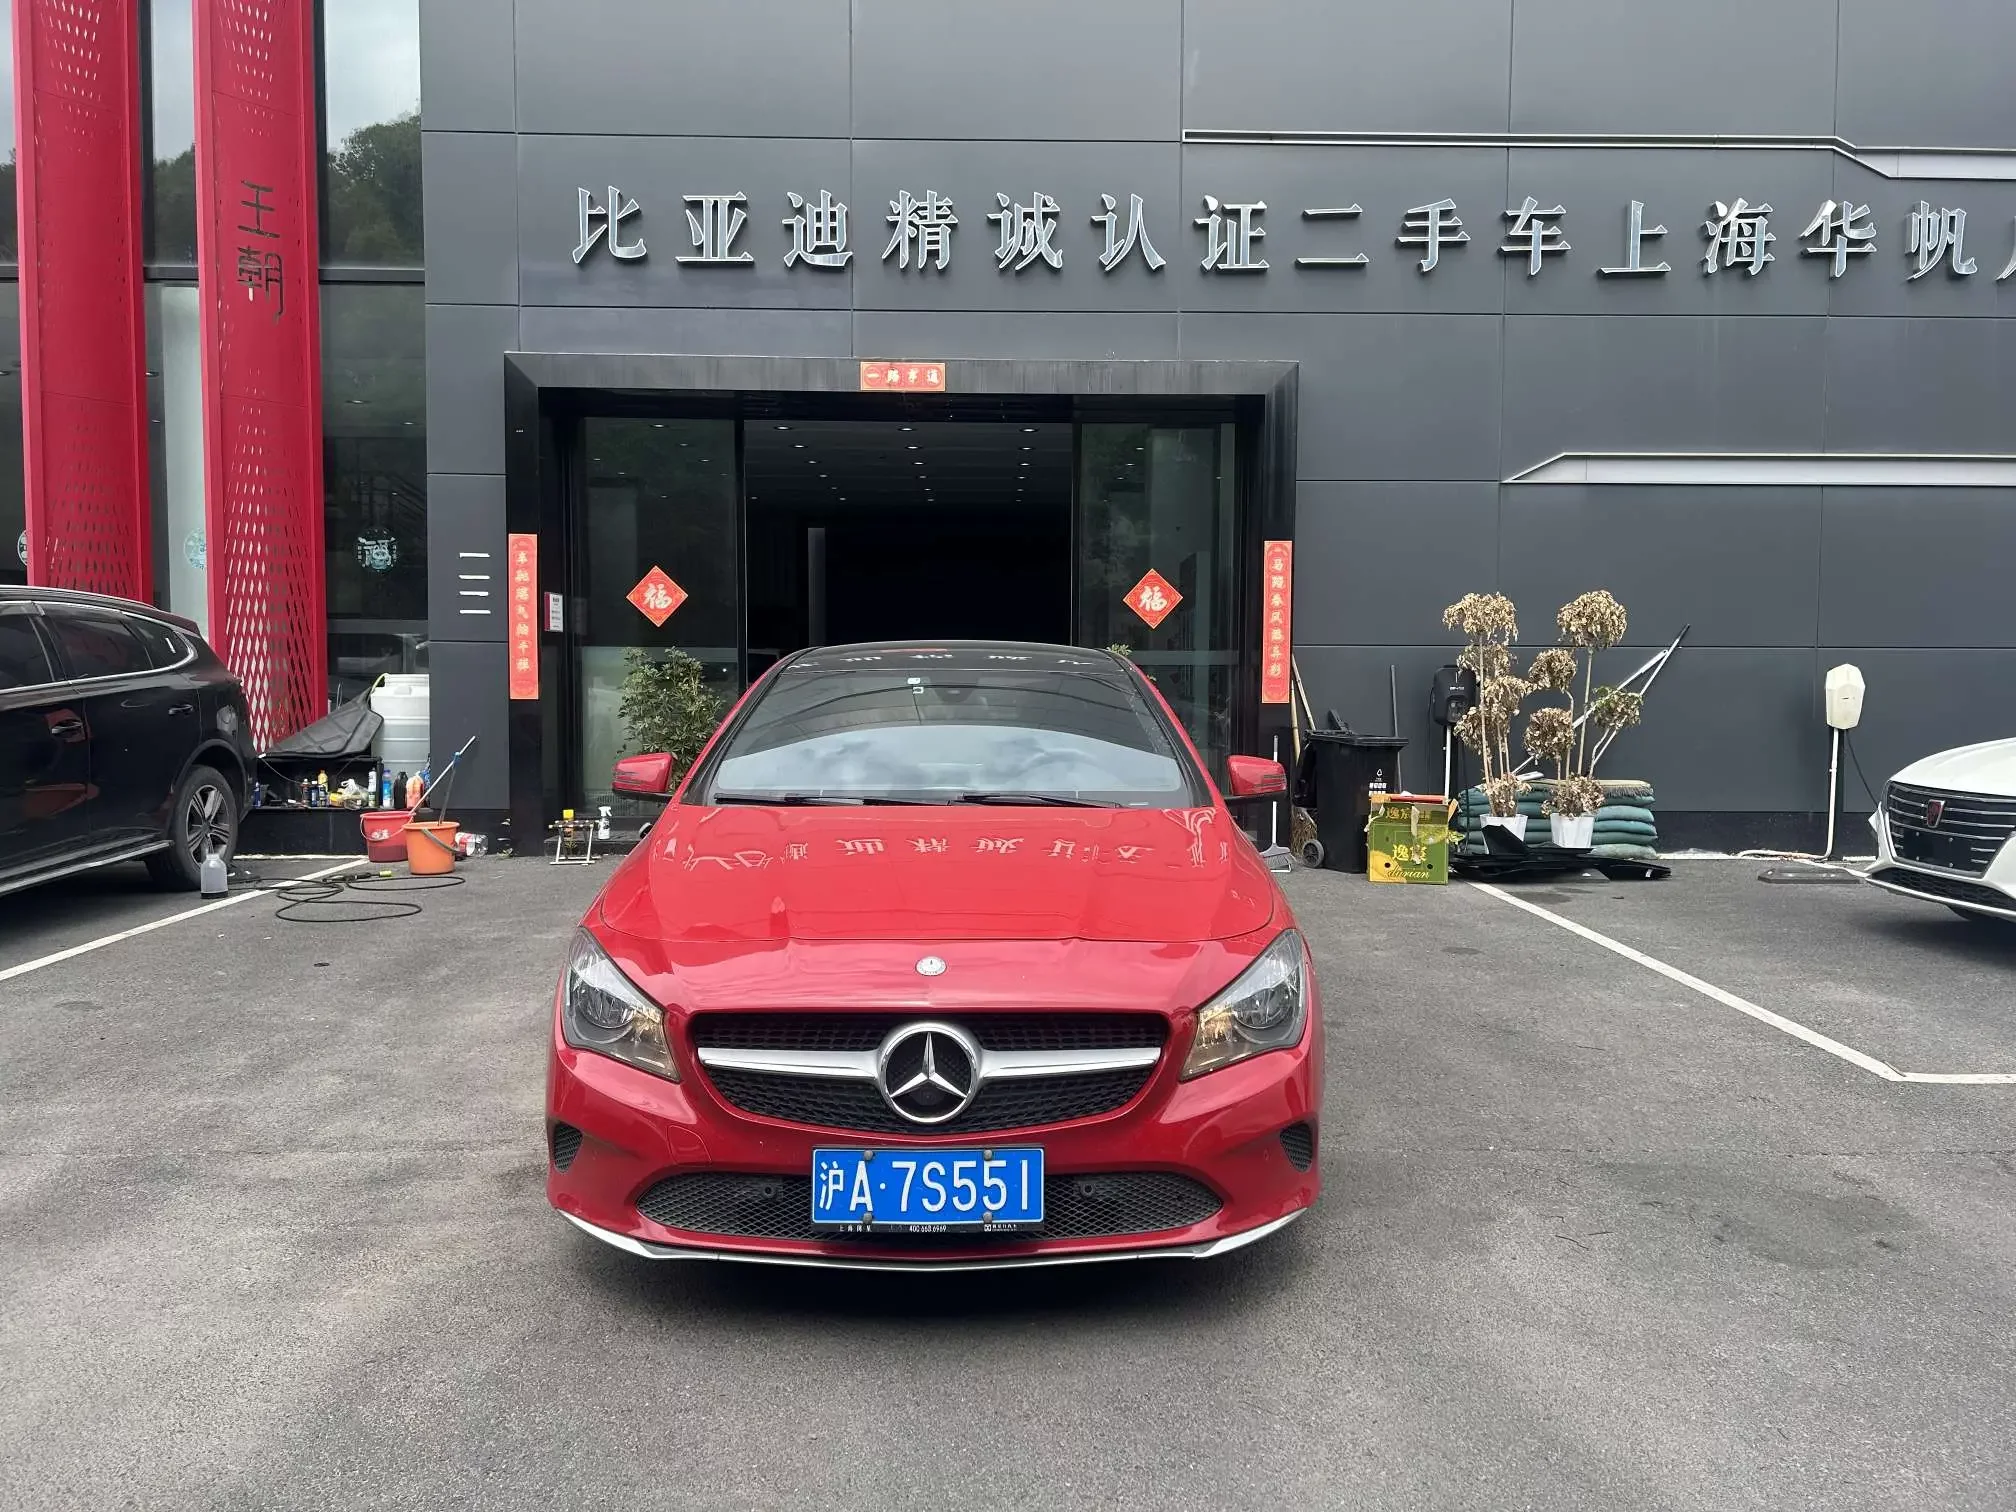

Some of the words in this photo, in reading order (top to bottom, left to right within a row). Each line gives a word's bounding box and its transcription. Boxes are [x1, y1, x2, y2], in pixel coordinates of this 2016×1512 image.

[237, 180, 284, 324] 王朝
[572, 185, 2016, 281] 比亚迪精诚认证二手车上海华帆
[643, 583, 673, 609] 福
[1138, 585, 1168, 611] 福
